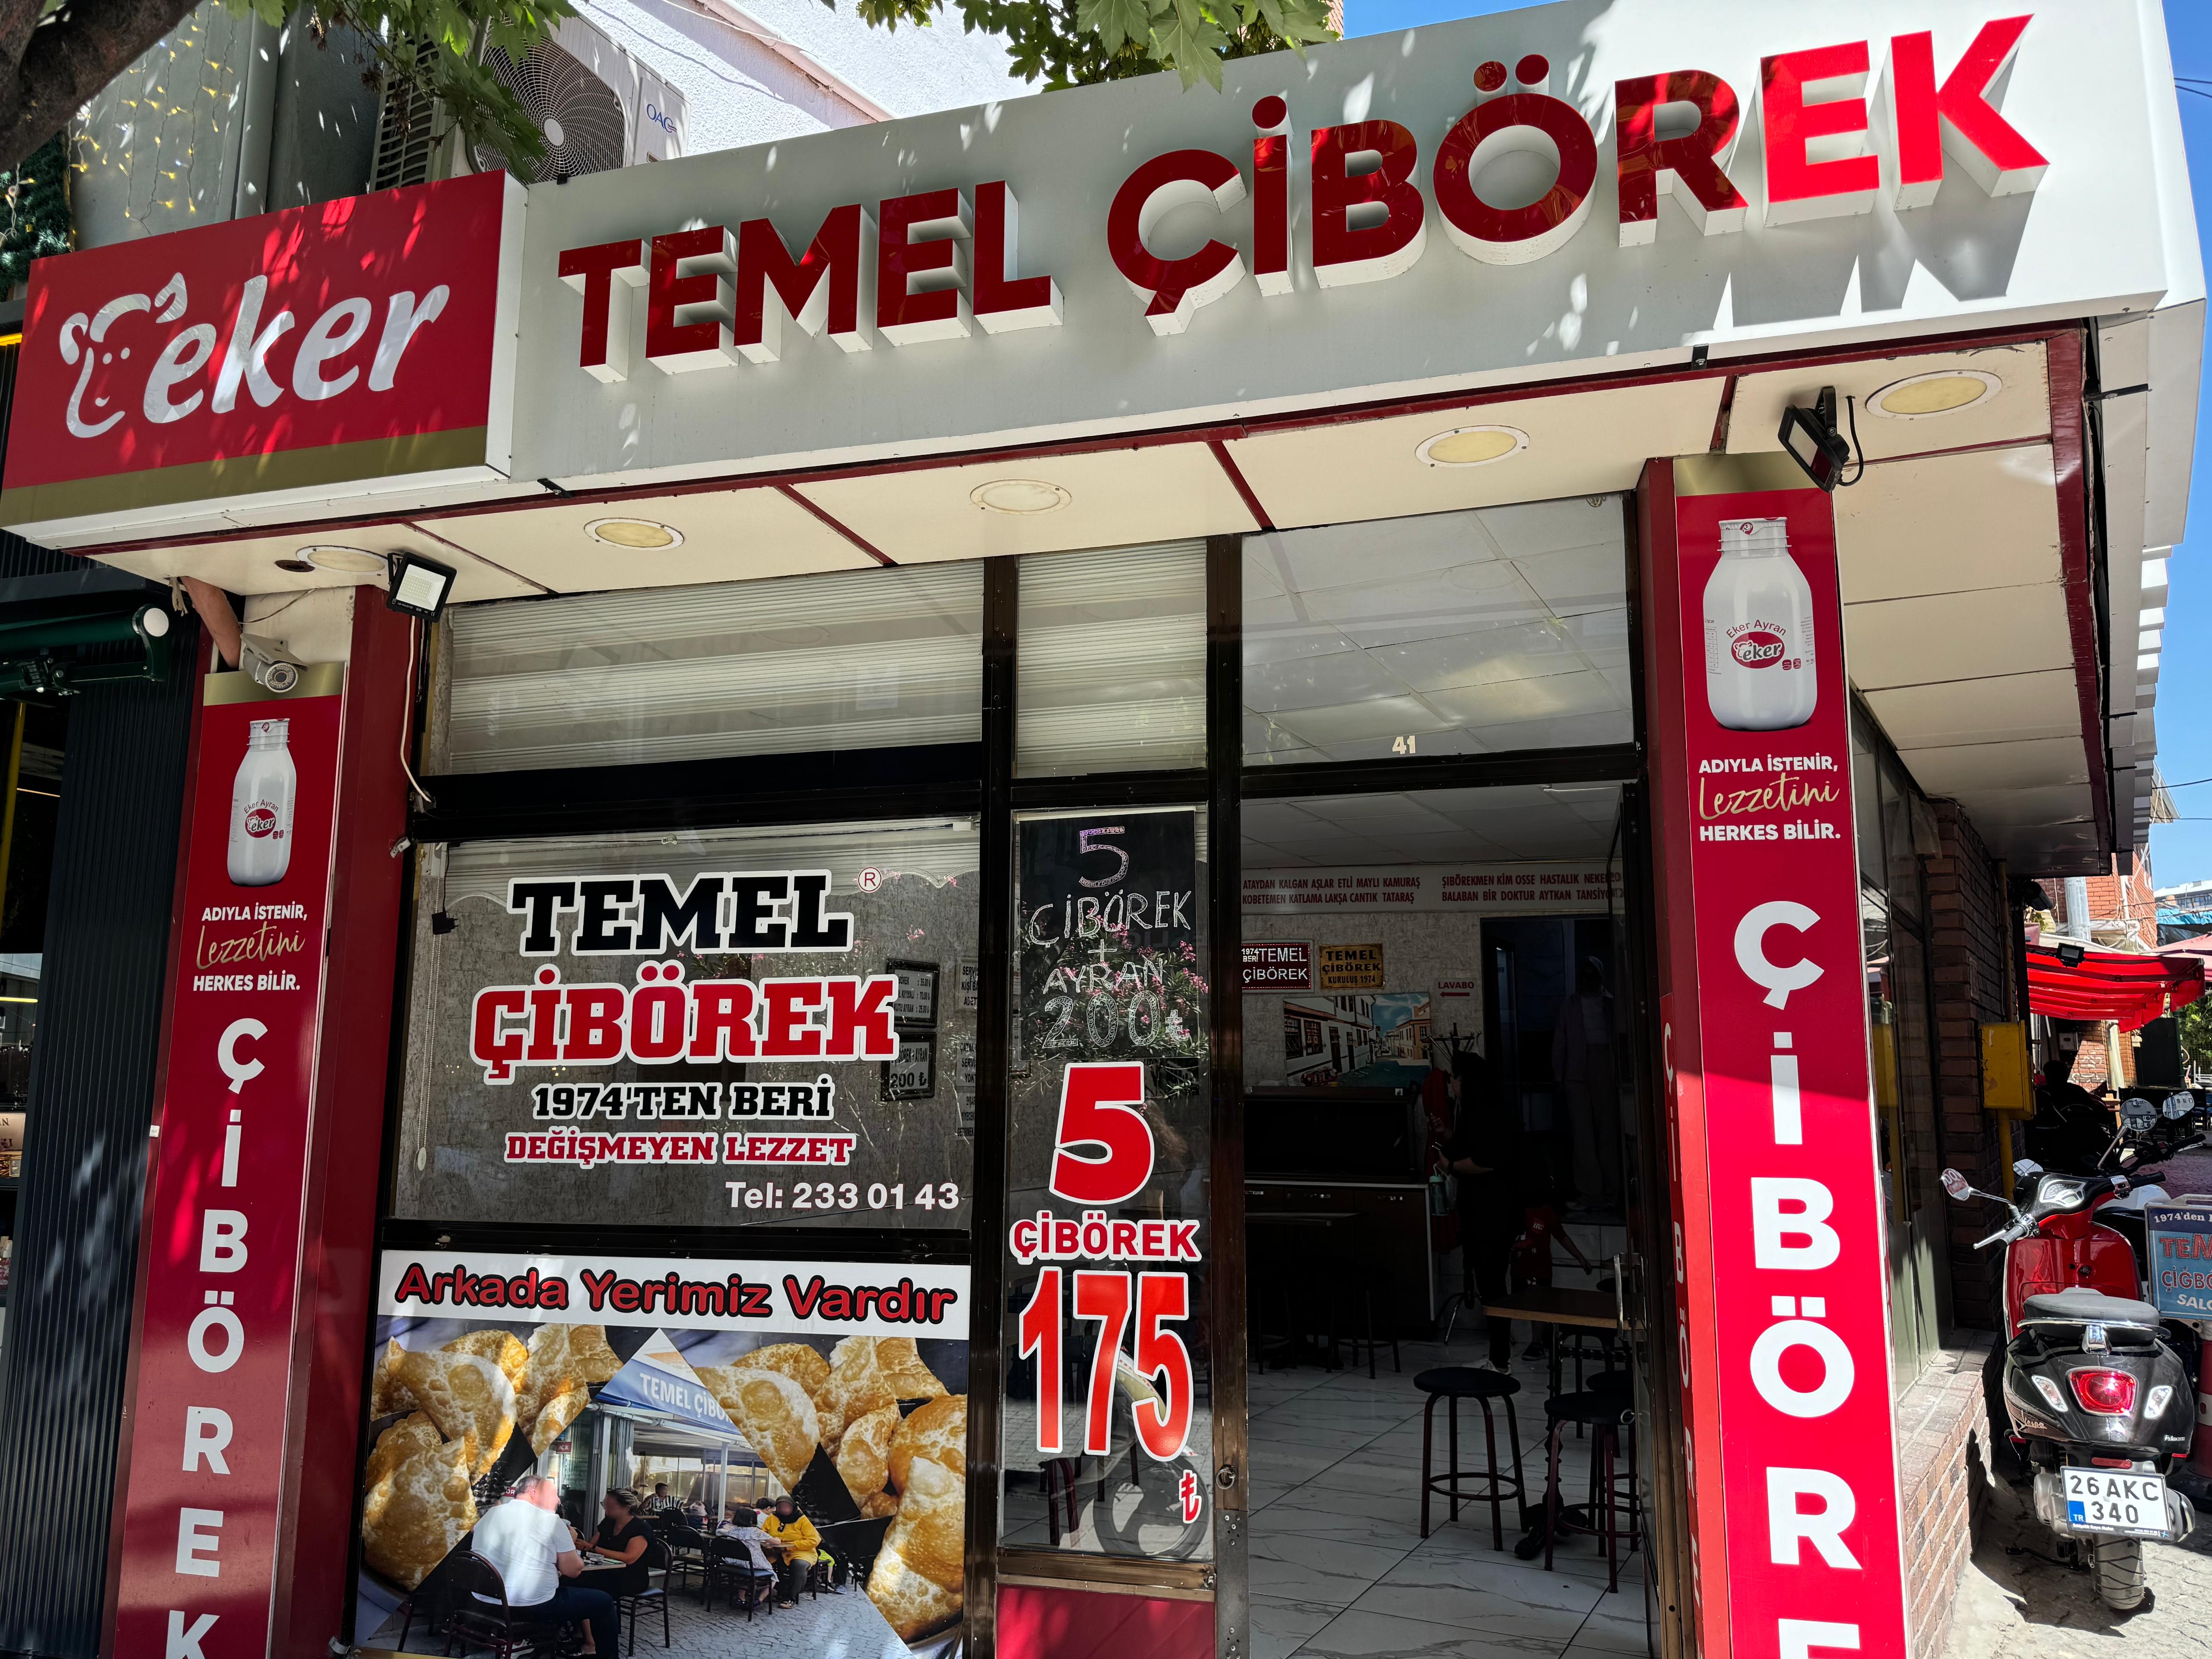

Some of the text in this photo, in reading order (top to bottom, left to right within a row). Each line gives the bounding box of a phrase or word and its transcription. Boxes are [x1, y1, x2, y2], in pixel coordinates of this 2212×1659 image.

[558, 14, 2049, 371] TEMEL ÇİBÖREK
[143, 275, 450, 424] eker
[1726, 620, 1786, 638] Eker Ayran
[1742, 643, 1781, 661] eker
[1392, 735, 1416, 755] 41
[1699, 752, 1838, 773] ADIYLA İSTENİR,
[244, 799, 279, 814] Eker Ayran
[1699, 772, 1840, 820] Lezzetini
[251, 818, 274, 831] eker
[1700, 819, 1841, 841] HERKES BİLİR.
[1079, 826, 1128, 887] 5
[1243, 876, 1421, 890] ATAYDAN KALGAN AŞLAR ETLİ MAYLI KAMURAŞ
[1497, 873, 1513, 885] KİM
[1515, 874, 1535, 885] OSSE
[1540, 874, 1579, 885] HASTALIK
[1243, 892, 1414, 905] KOBETEMEN KATLAMA LAKŞA CANTIK TATARAŞ
[1442, 890, 1478, 902] BALABAN
[1483, 889, 1497, 901] BİR
[1501, 890, 1535, 901] DOKTUR
[1539, 890, 1571, 900] AYTKAN
[201, 901, 307, 921] ADIYLA İSTENİR,
[509, 872, 851, 954] TEMEL
[1029, 889, 1191, 948] ÇİBÖREK
[197, 921, 305, 969] Lezzetini
[1259, 947, 1307, 962] TEMEL
[1326, 950, 1377, 962] TEMEL
[1043, 958, 1163, 994] AYRAN
[1243, 966, 1308, 983] ÇİBÖREK
[1322, 962, 1381, 974] ÇİBÖREK
[193, 969, 300, 992] HERKES BİLİR.
[1328, 975, 1376, 985] KURULUŞ 1974
[1438, 981, 1475, 989] LAVABO
[472, 963, 896, 1082] ÇİBÖREK
[533, 1075, 833, 1118] 1974'TEN BERİ
[1051, 1064, 1153, 1203] 5
[506, 1128, 855, 1167] DEĞİŞMEYEN LEZZET
[725, 1181, 960, 1210] Tel: 233 01 43
[2154, 1212, 2205, 1223] 1974'den
[1012, 1211, 1200, 1261] ÇİBÖREK
[395, 1262, 957, 1324] Arkada Yerimiz Vardır
[165, 1018, 268, 1659] ÇİBÖREK
[1021, 1268, 1191, 1459] 175
[640, 1372, 691, 1409] TEMEL
[2070, 1475, 2159, 1501] 26 AKC
[2073, 1513, 2084, 1522] TR
[2091, 1501, 2139, 1524] 340
